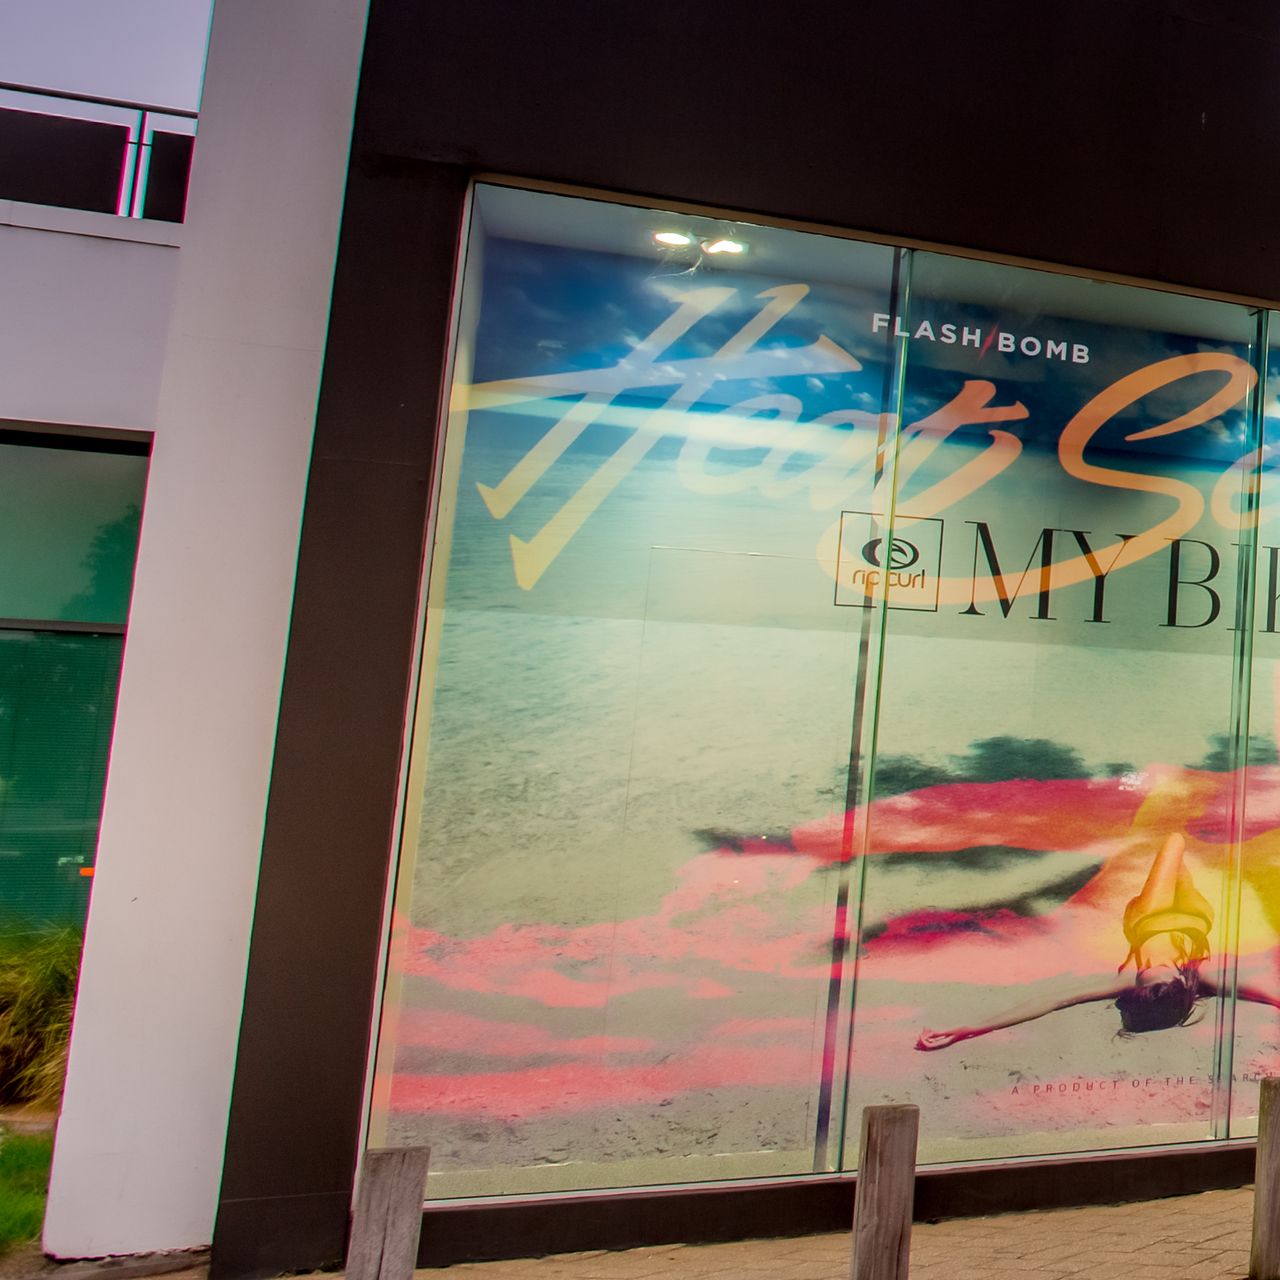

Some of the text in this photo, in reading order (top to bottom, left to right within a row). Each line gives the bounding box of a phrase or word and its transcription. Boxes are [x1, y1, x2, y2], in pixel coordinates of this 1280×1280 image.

[871, 312, 1092, 364] FLASH BOMB
[957, 520, 1137, 624] MY
[1011, 1086, 1019, 1095] A
[1033, 1080, 1120, 1095] PRODUCT
[1131, 1079, 1152, 1088] OF
[1165, 1076, 1196, 1087] THE
